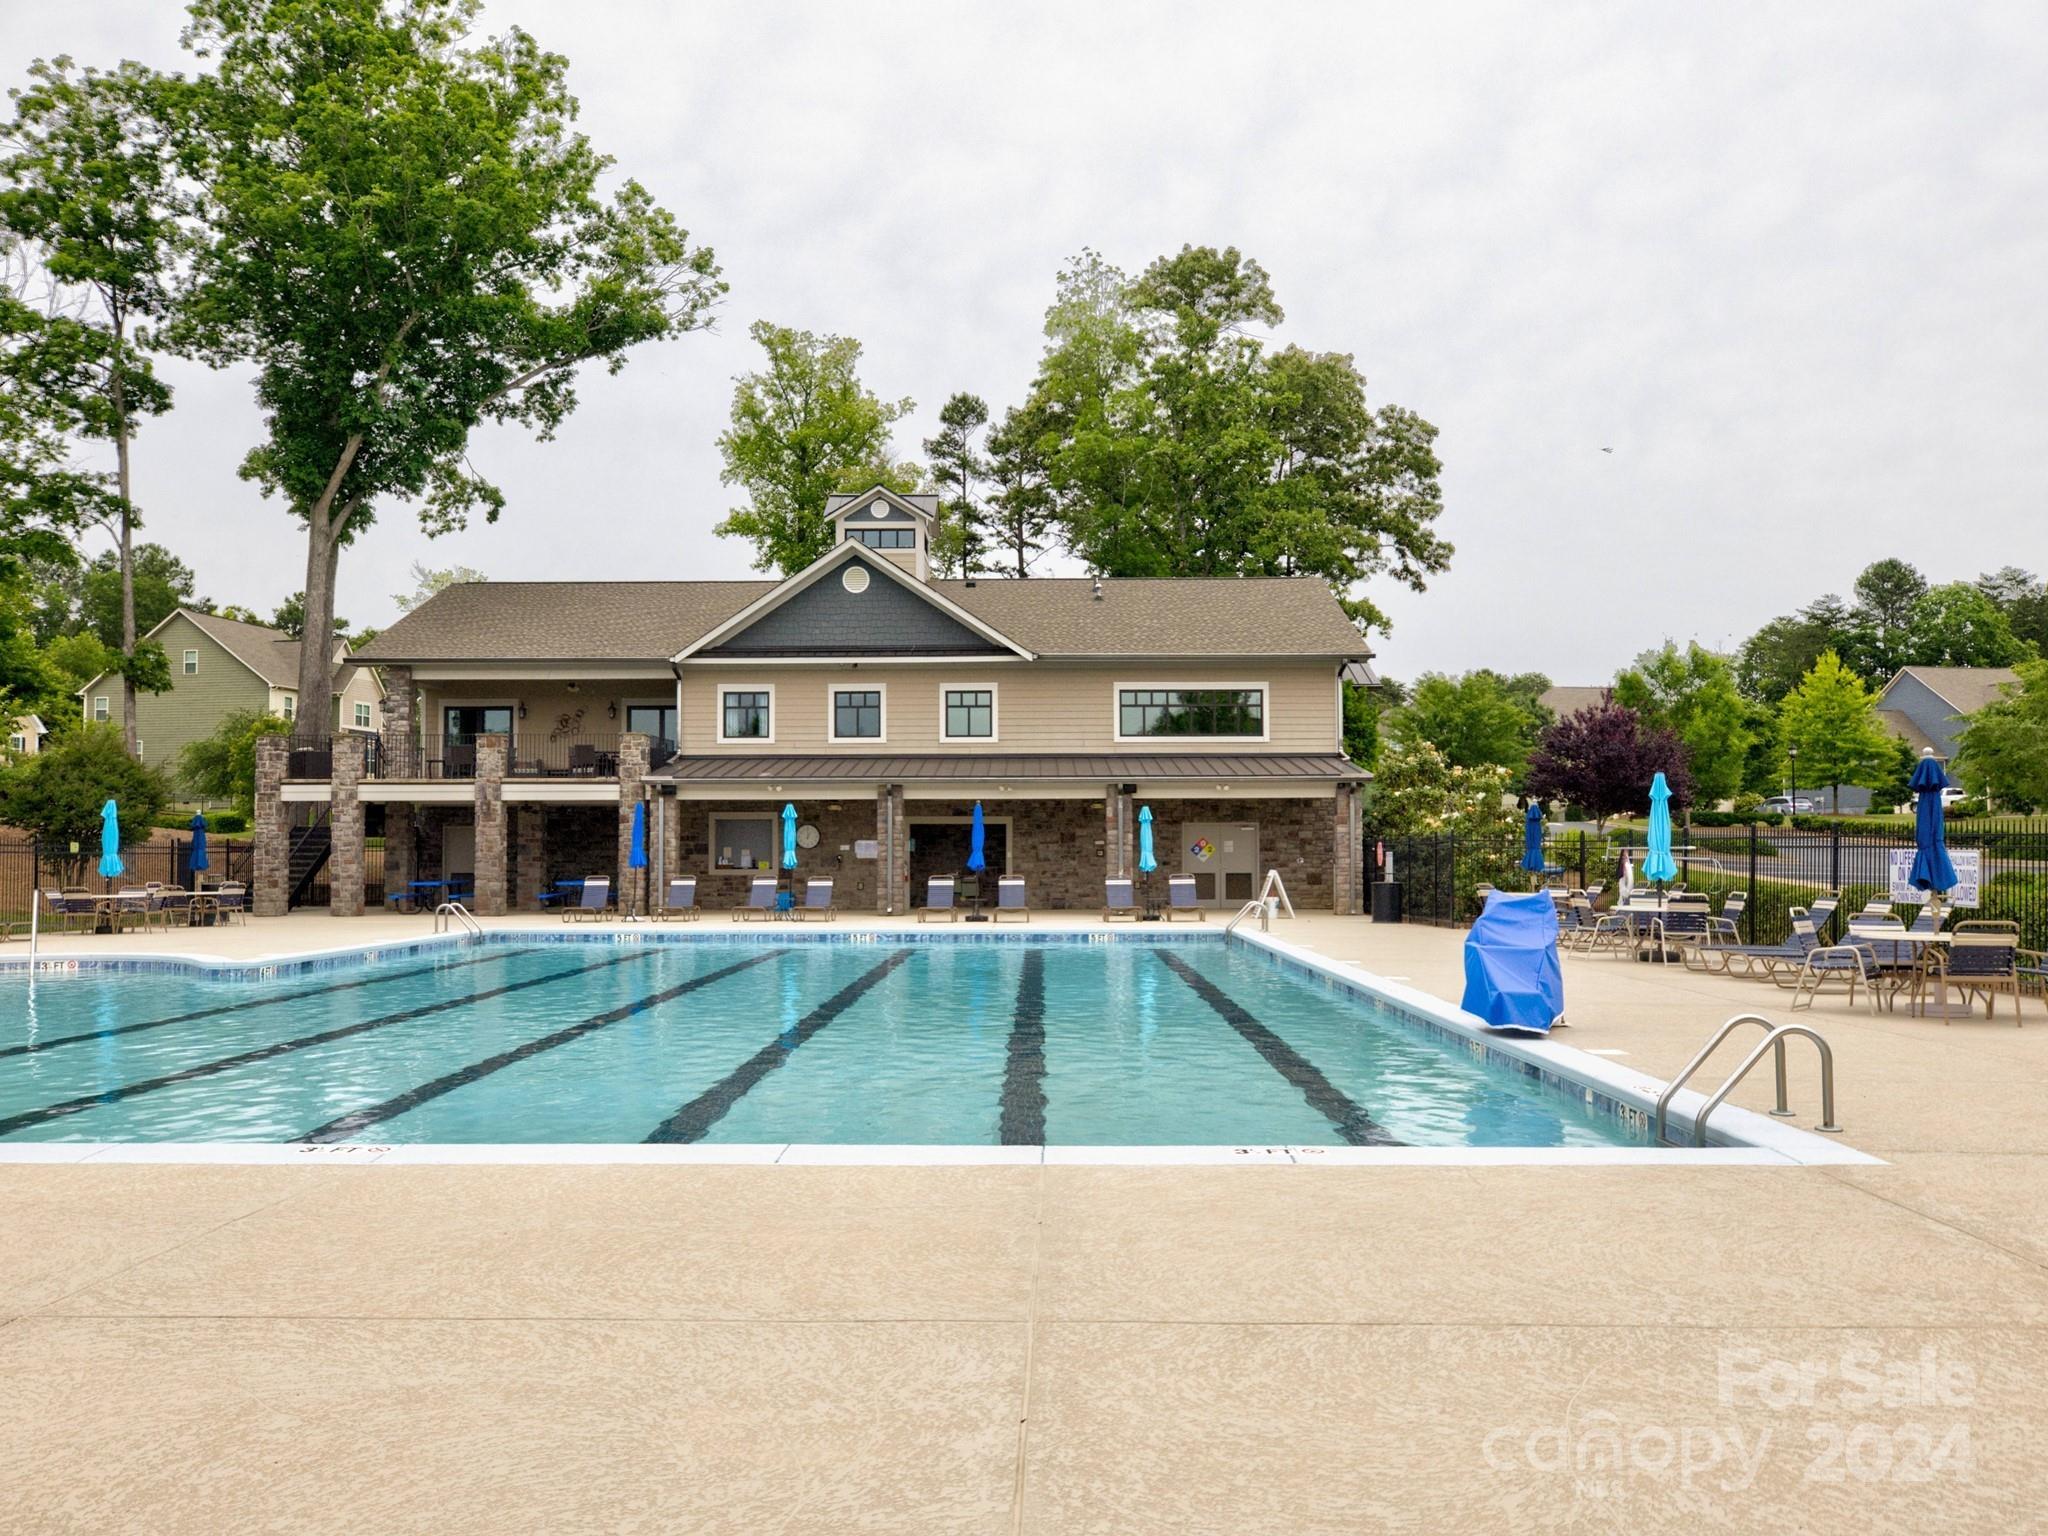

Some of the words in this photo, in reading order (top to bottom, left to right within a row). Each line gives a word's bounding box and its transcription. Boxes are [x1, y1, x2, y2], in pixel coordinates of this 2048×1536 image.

[1890, 850, 1899, 865] NO
[1900, 850, 1917, 865] LIFEG
[1898, 866, 1906, 881] ON
[1959, 869, 1977, 885] DIVING
[1892, 881, 1906, 892] SWIM
[53, 961, 64, 970] FT
